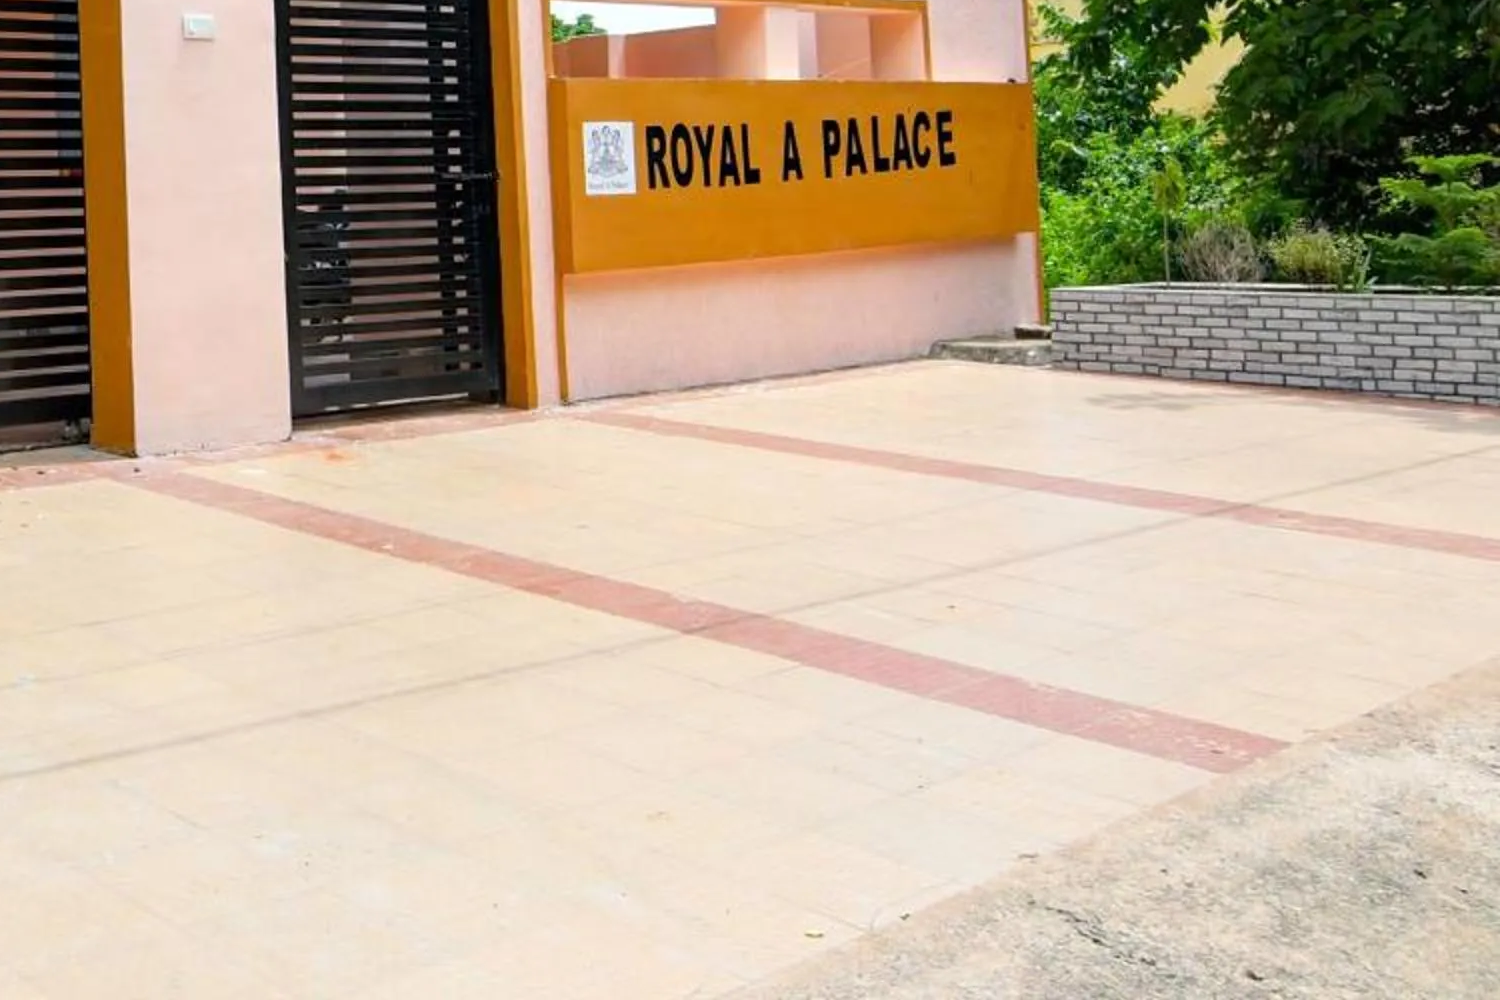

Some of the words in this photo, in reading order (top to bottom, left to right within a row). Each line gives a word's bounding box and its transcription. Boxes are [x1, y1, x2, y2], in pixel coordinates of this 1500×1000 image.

[645, 122, 761, 189] ROYAL
[782, 120, 804, 181] A
[822, 110, 957, 178] PALACE
